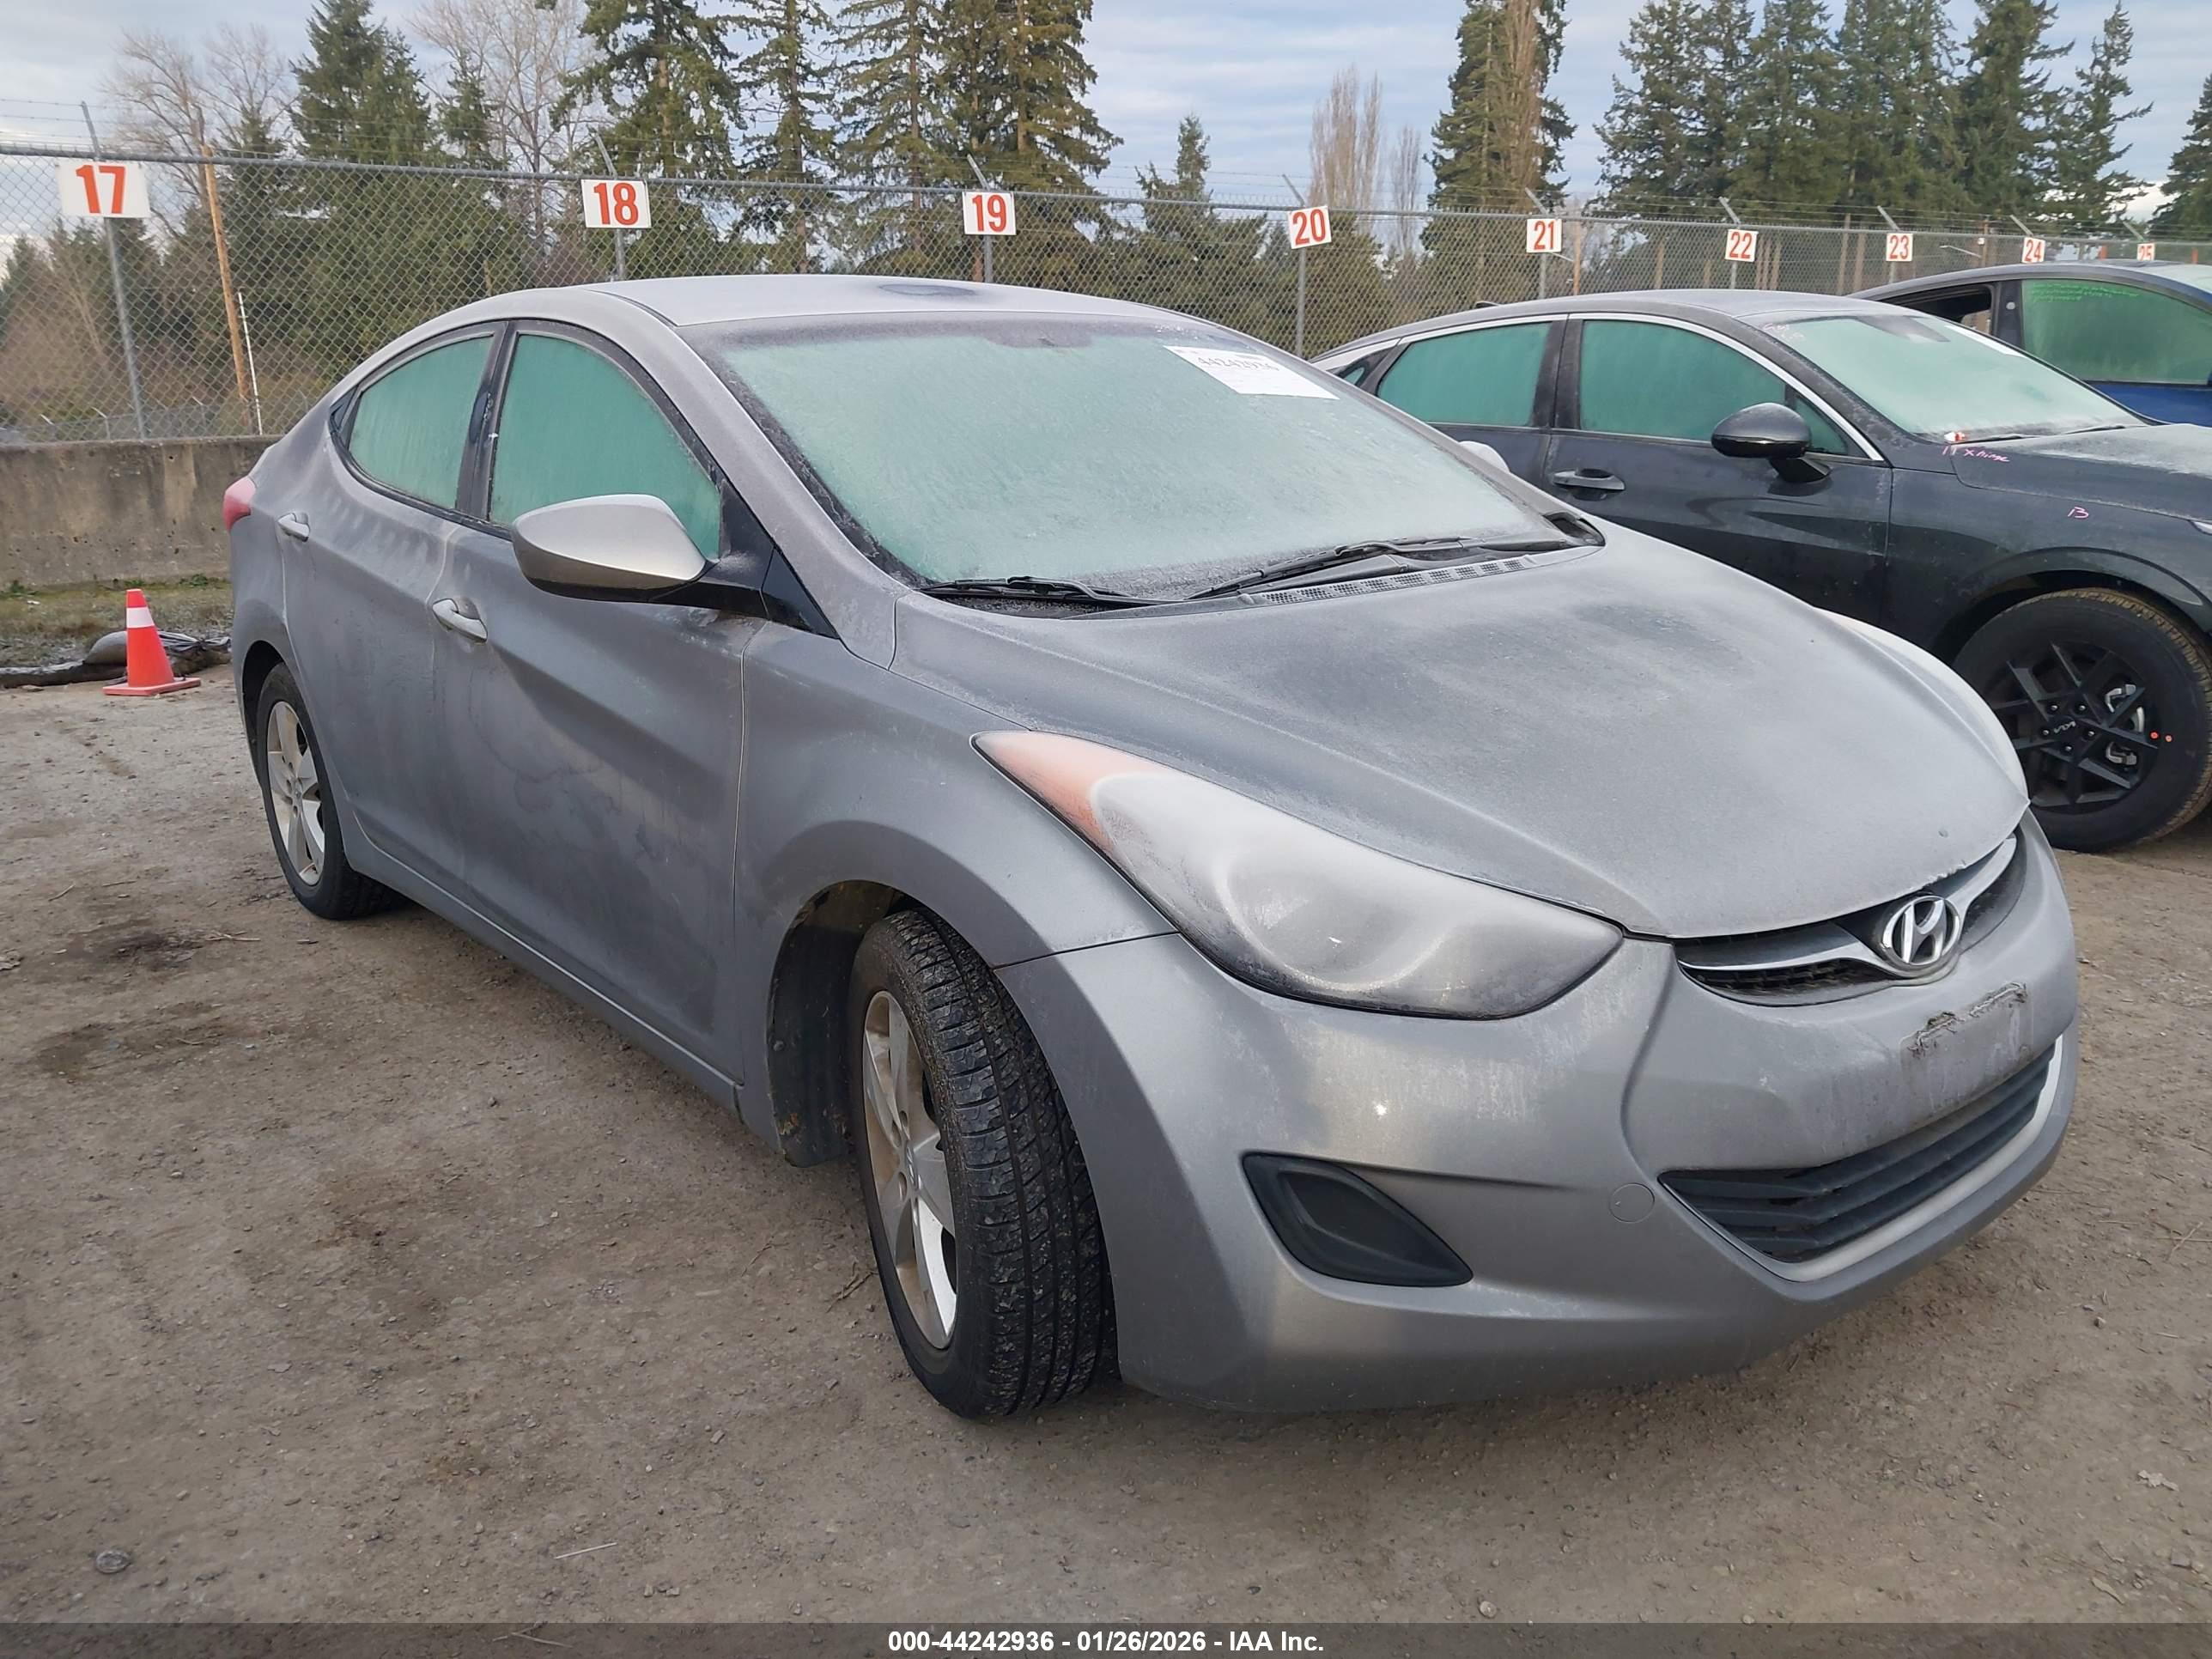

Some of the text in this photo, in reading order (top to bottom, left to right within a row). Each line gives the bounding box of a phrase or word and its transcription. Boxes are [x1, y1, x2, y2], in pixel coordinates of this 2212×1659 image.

[76, 164, 125, 214] 17
[593, 182, 639, 226] 18
[971, 194, 1007, 232] 19
[1292, 208, 1327, 246] 20
[1534, 221, 1555, 251] 21
[1729, 231, 1753, 259] 22
[1889, 234, 1910, 259] 23
[2023, 240, 2042, 262] 24
